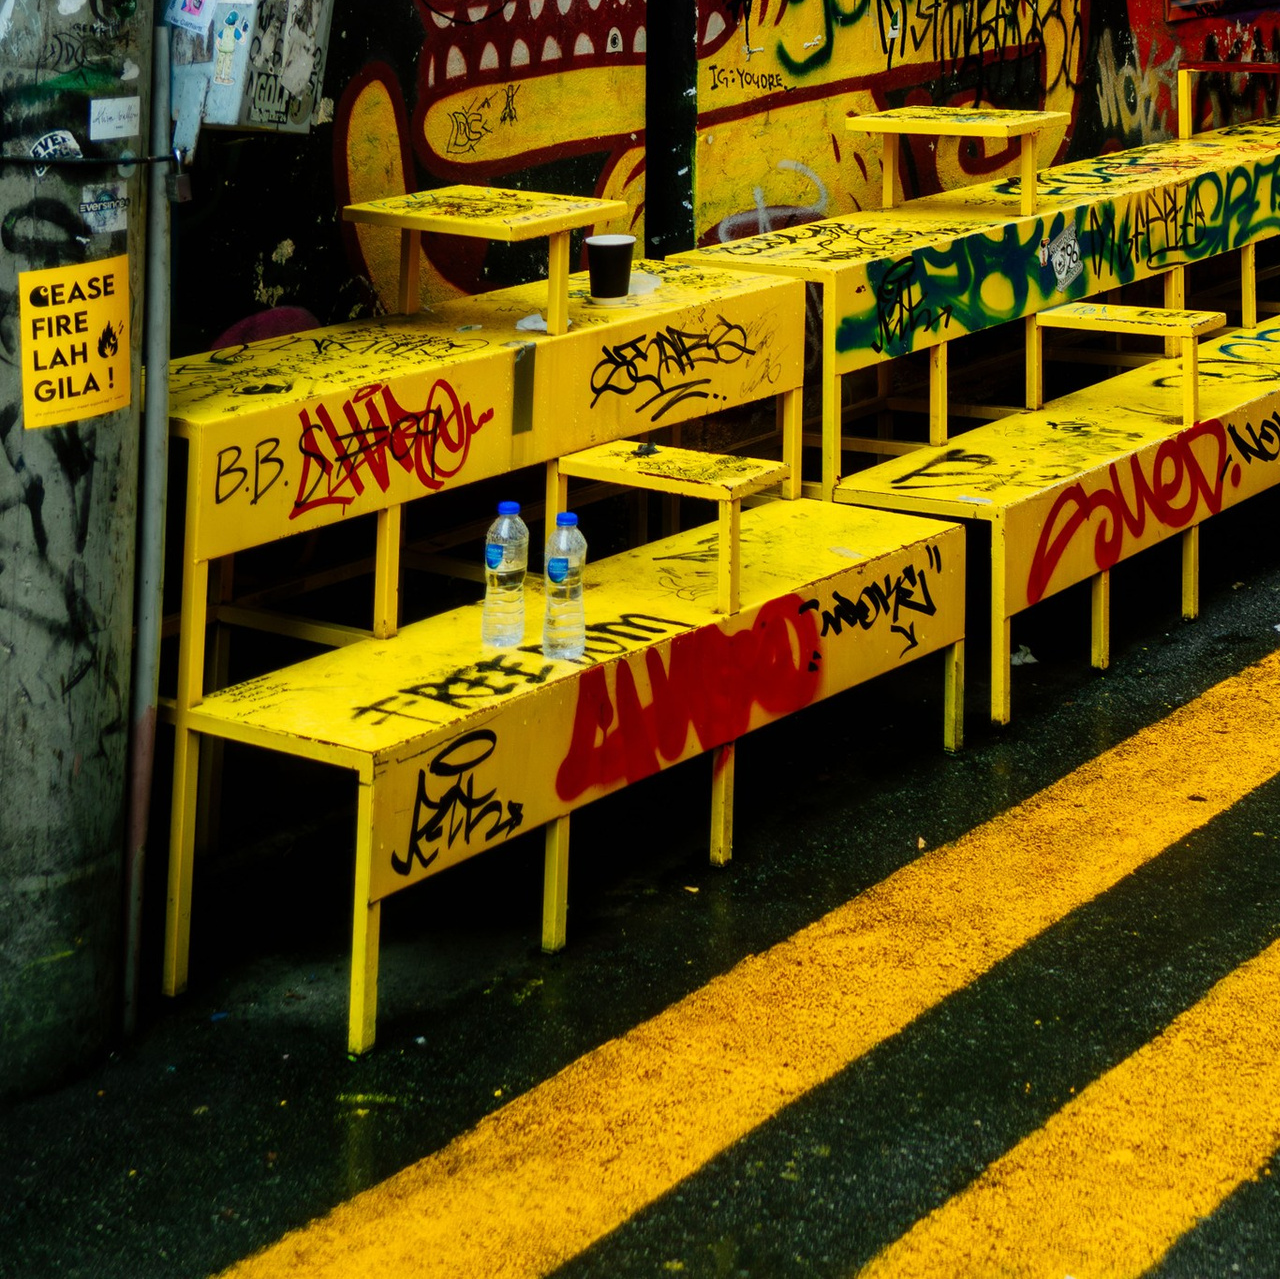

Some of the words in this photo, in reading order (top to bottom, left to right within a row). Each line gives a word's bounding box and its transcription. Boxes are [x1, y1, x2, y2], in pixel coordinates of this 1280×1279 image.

[29, 274, 115, 308] CEASE
[32, 310, 88, 340] FIRE
[33, 342, 88, 372] LAH
[34, 372, 100, 403] GILA
